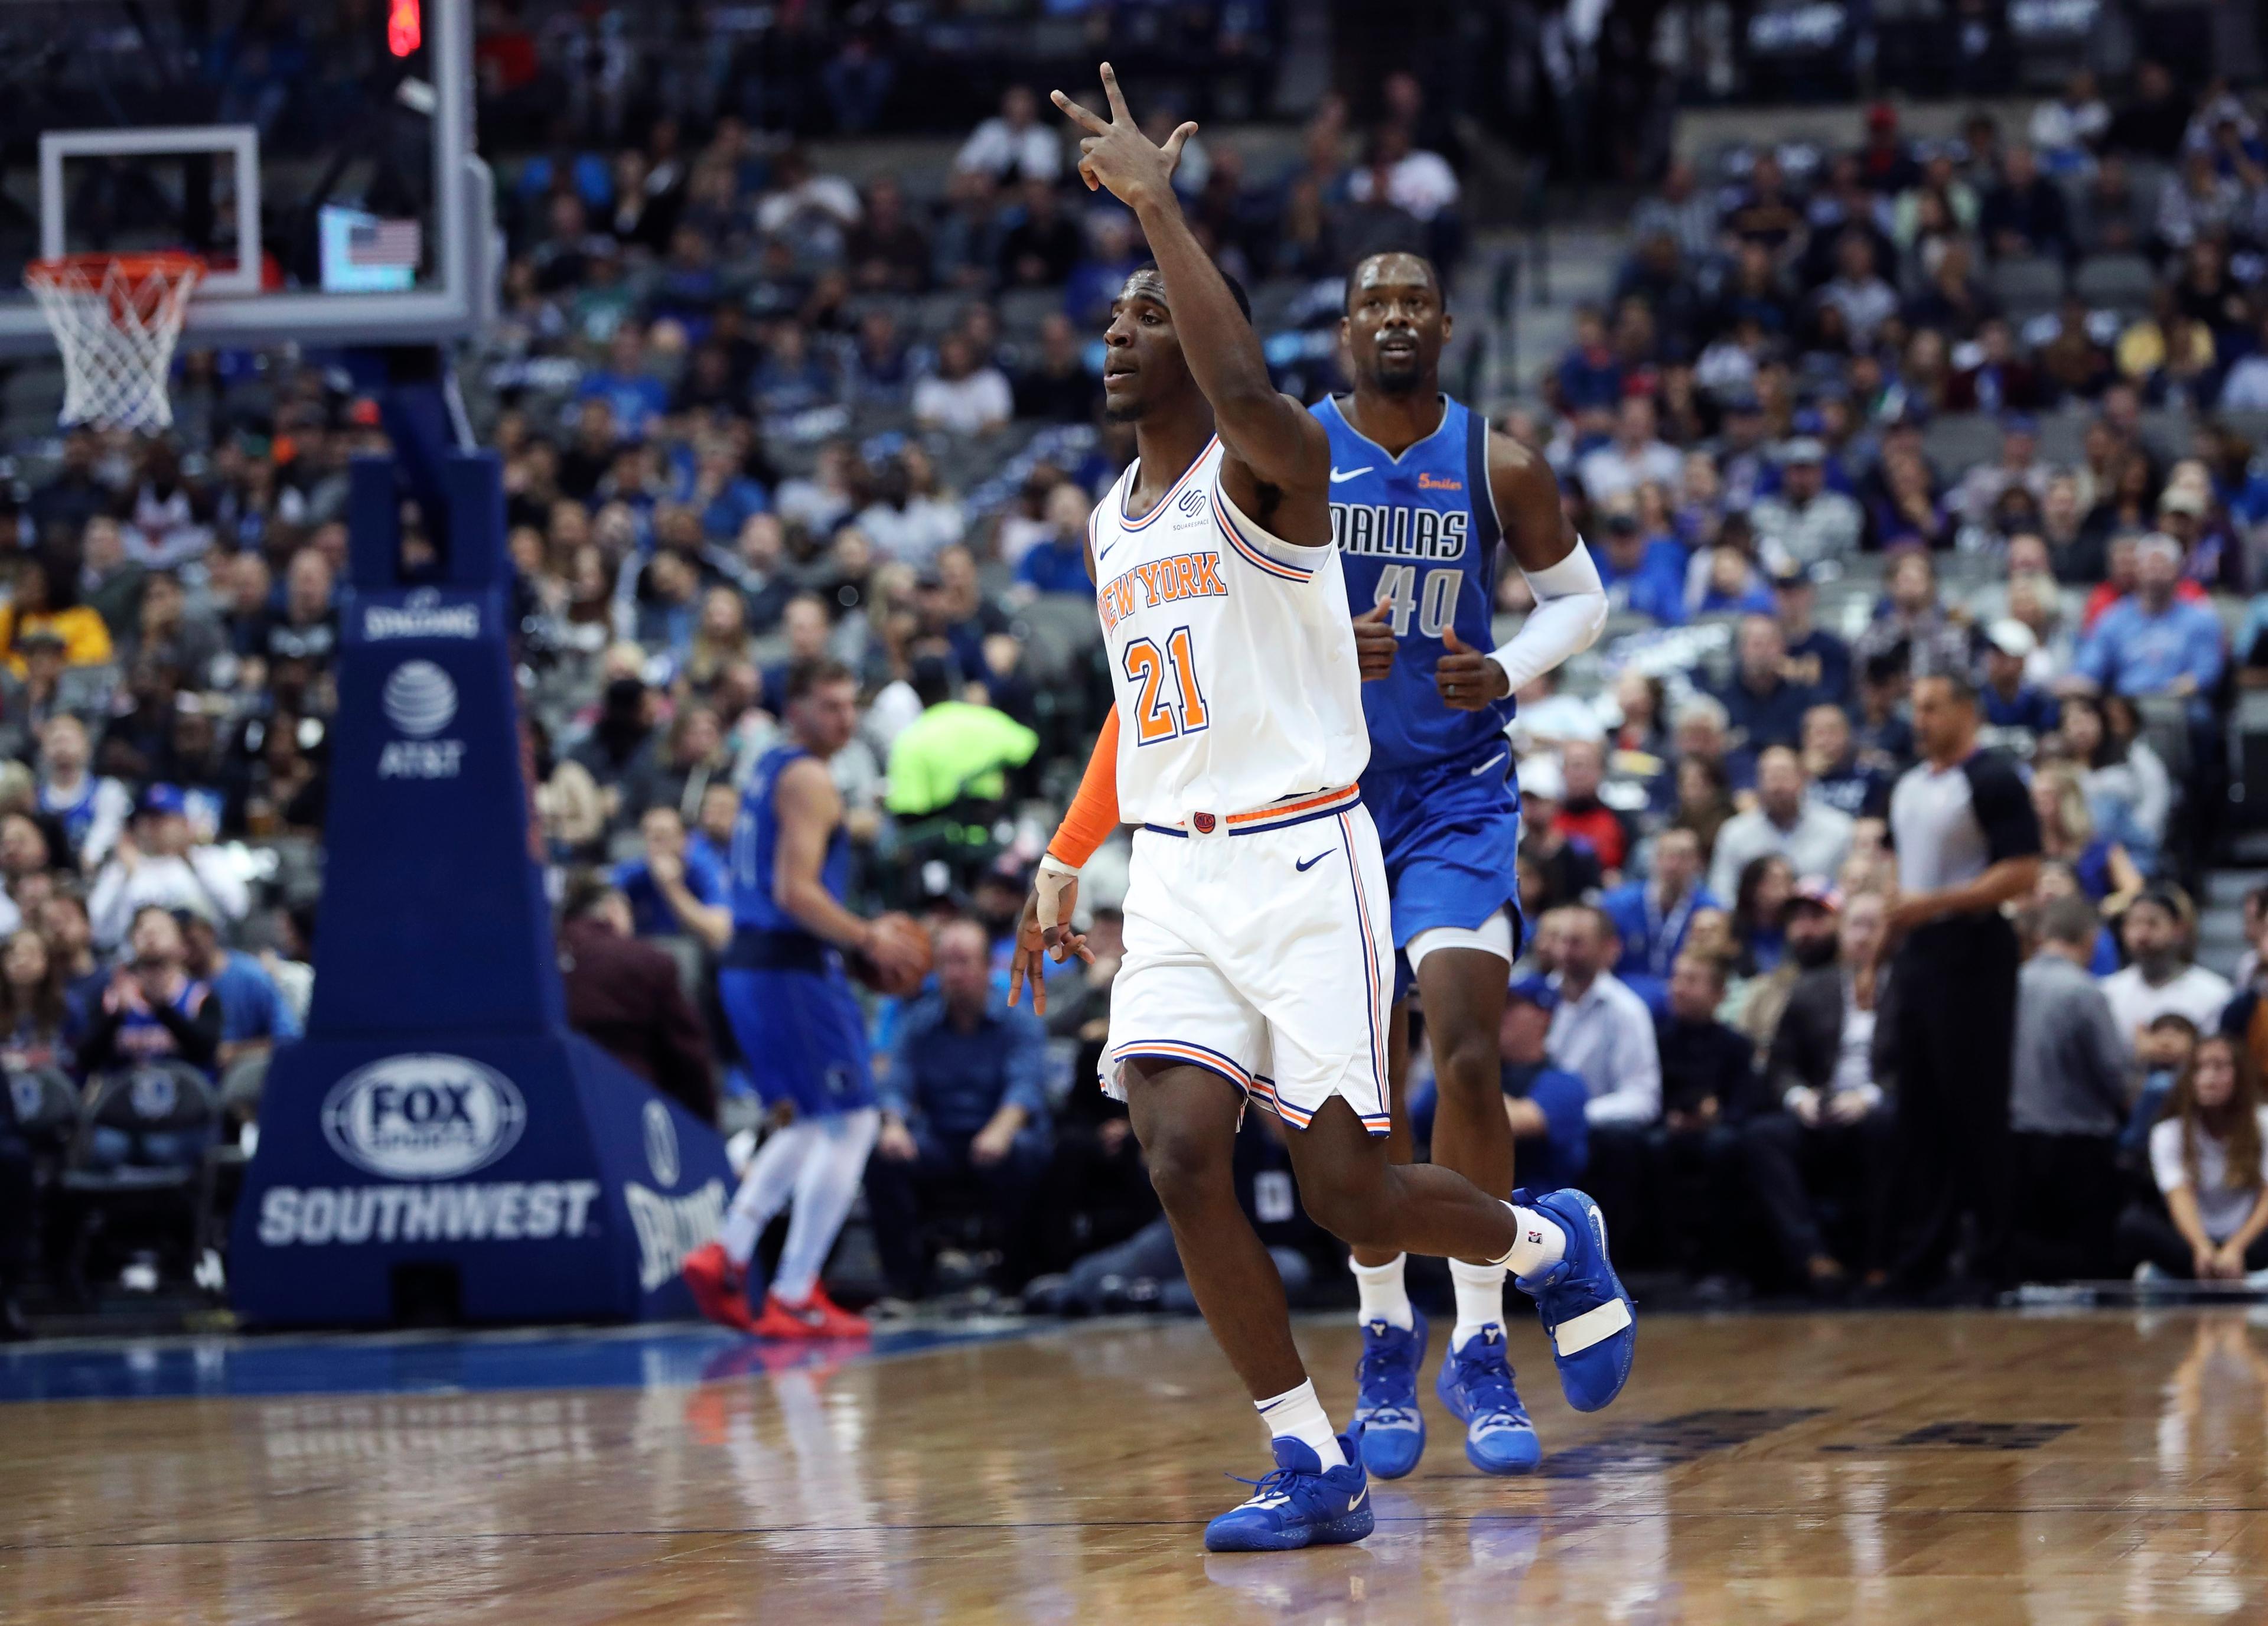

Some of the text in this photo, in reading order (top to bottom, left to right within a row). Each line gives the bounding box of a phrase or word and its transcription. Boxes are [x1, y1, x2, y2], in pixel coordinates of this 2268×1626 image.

[1172, 519, 1210, 531] SQUARESPACE
[1329, 502, 1468, 561] DALLAS
[1097, 551, 1229, 637] NEW YORK
[1374, 564, 1464, 638] 40
[1122, 625, 1209, 747] 21
[377, 739, 468, 780] AT&T
[372, 1083, 474, 1131] FOX
[259, 1182, 600, 1246] SOUTHWEST
